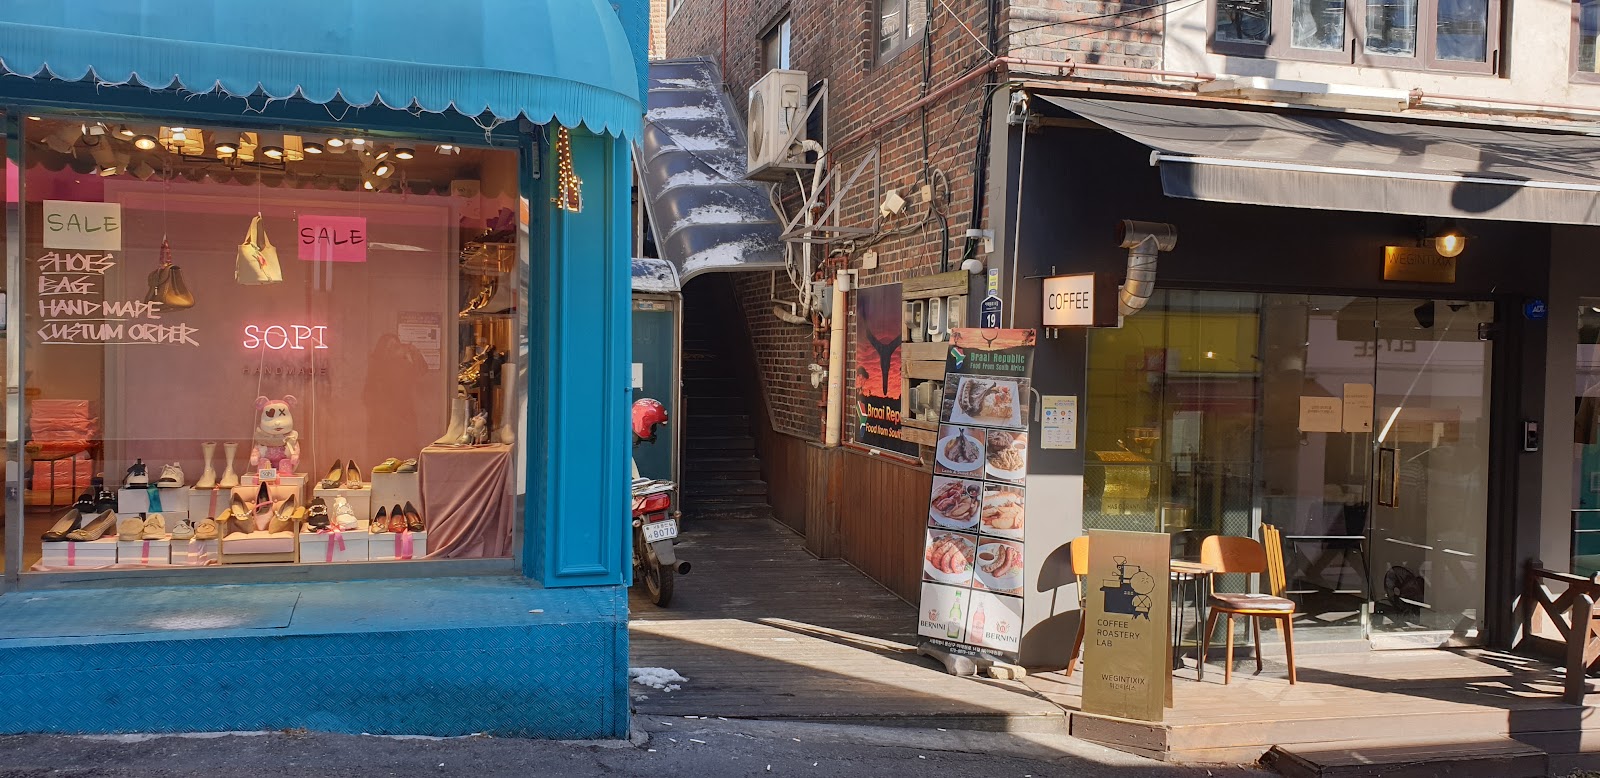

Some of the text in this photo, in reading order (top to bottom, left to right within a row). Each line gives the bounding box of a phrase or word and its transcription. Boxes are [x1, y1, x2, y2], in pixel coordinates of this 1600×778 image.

[47, 213, 120, 233] SALE
[300, 227, 364, 245] SALE
[37, 252, 116, 275] SHOES
[38, 276, 96, 295] BAG
[1048, 291, 1089, 310] COFFEE
[986, 313, 996, 328] 19
[127, 322, 200, 347] ORDER
[243, 324, 329, 350] SOPI
[970, 352, 1025, 364] Braai Republic
[242, 367, 328, 377] HANDMADE
[867, 403, 902, 426] Braai Rep
[865, 422, 878, 434] Food
[653, 527, 675, 538] 8070
[920, 620, 946, 631] BERNINI
[1097, 619, 1129, 629] COFFEE
[985, 632, 1018, 643] BERNINI
[1096, 629, 1140, 639] ROASTERY
[1096, 639, 1113, 647] LAB
[1101, 674, 1145, 685] WEGINTIXIX
